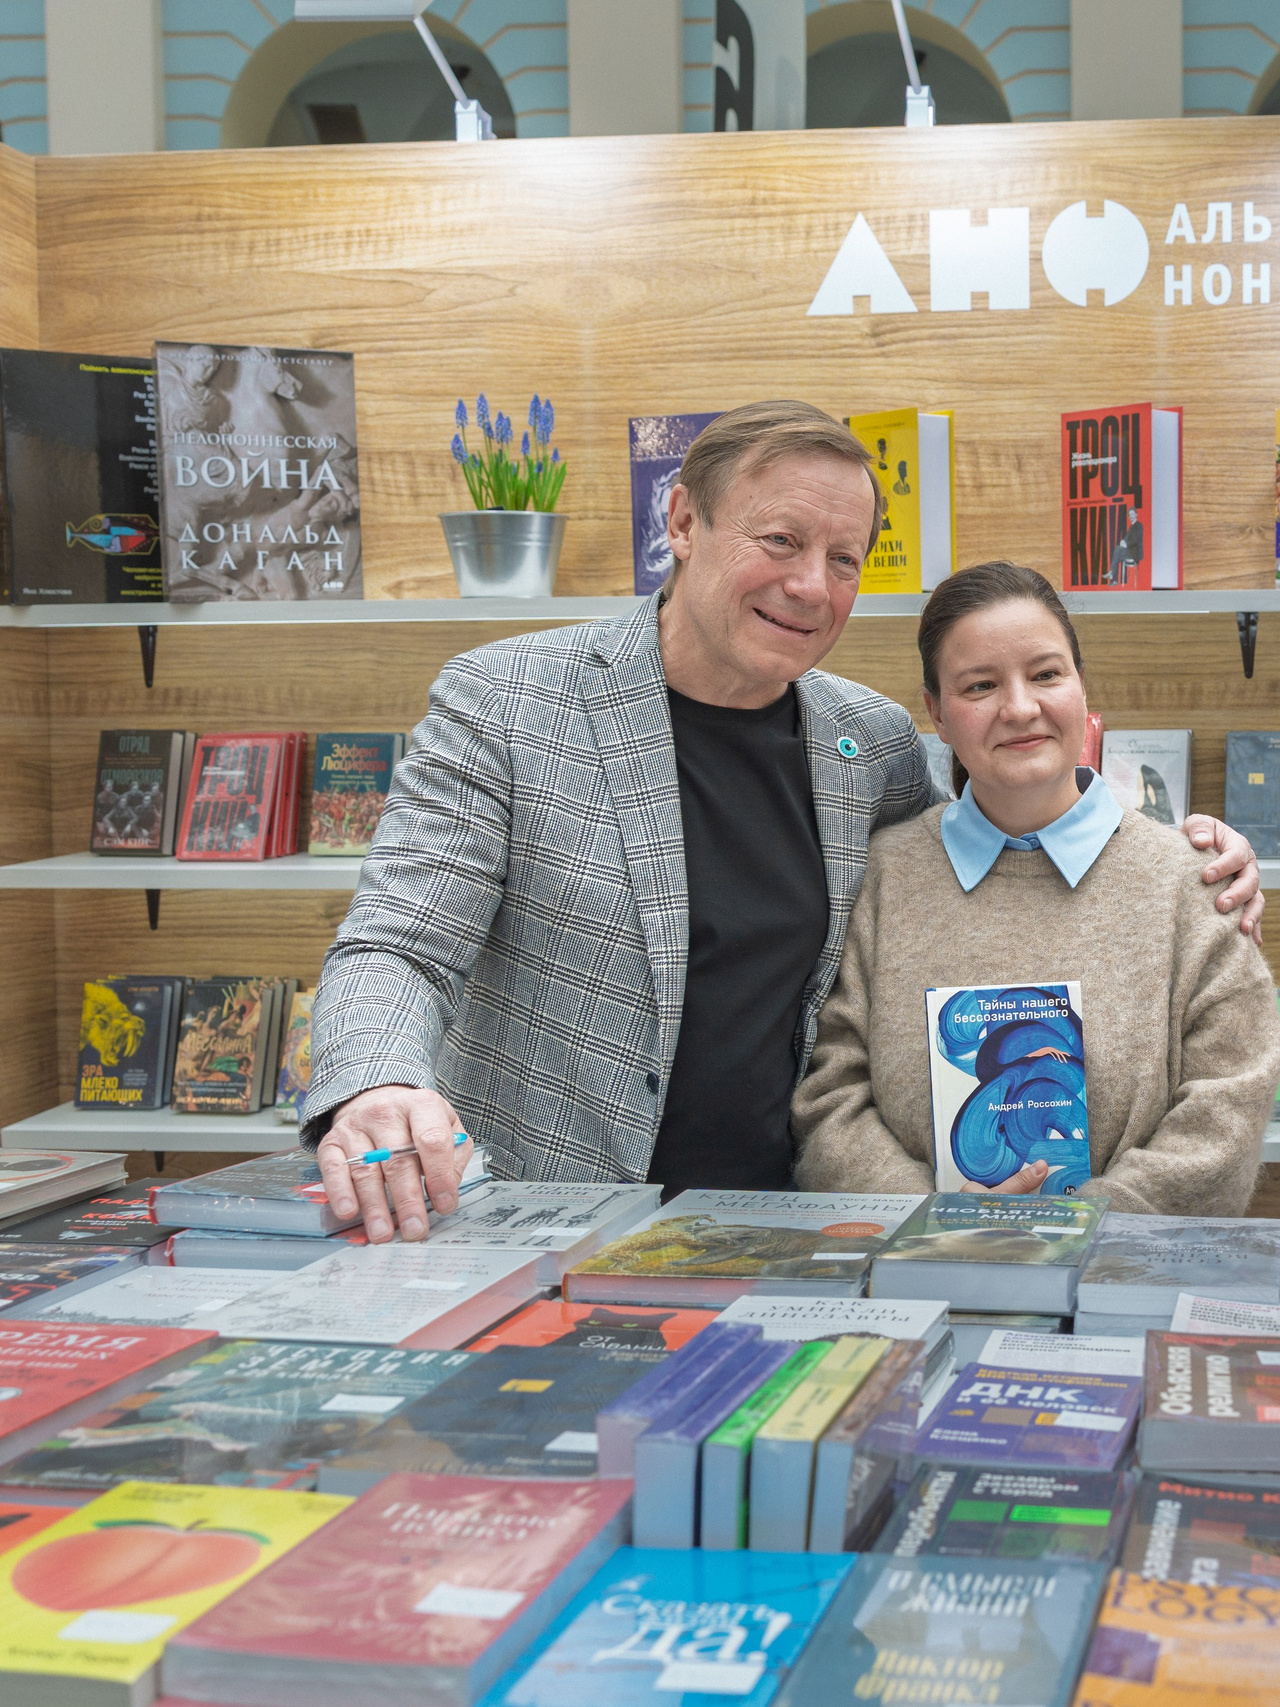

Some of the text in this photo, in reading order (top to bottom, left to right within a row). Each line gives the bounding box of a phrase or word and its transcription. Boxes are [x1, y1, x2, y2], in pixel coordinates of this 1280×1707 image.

[173, 431, 338, 450] ПЕЛОПОННЕССКАЯ
[1066, 412, 1143, 509] ТРОЦ
[174, 451, 344, 491] ВОЙНА
[177, 522, 345, 545] ДОНАЛЬД
[872, 539, 903, 554] ТИХИ
[180, 550, 345, 572] КАГАН
[873, 553, 907, 569] ВЕЩИ
[119, 735, 150, 754] ОТРЯД
[331, 743, 379, 761] Эффект
[321, 755, 387, 775] Люцифера
[197, 745, 270, 805] ТРОЦ
[977, 997, 1069, 1011] Тайны нашего
[954, 1008, 1069, 1024] бессознательного
[82, 1064, 103, 1077] ЭРА
[81, 1076, 119, 1089] МЛЕКО
[80, 1088, 144, 1102] ПИТАЮЩИХ
[988, 1099, 1073, 1112] Андрей Россохин
[523, 1184, 614, 1192] Первые
[698, 1193, 801, 1203] КОНЕЦ
[715, 1201, 907, 1212] МЕГАФАУНЫ
[930, 1206, 1089, 1218] НЕОБЪЯТНЫЙ
[979, 1213, 1032, 1221] МИР
[738, 1311, 910, 1322] ДИНОЗАВРЫ
[768, 1305, 897, 1314] УМИРАЛИ
[0, 1330, 147, 1351] РЕМЯ
[586, 1335, 616, 1343] ОТ
[0, 1346, 113, 1361] МЕННЫХ
[237, 1356, 401, 1376] ЗЕМЛИ
[960, 1381, 1084, 1404] ДНК
[1018, 1399, 1119, 1415] человек
[991, 1487, 1055, 1498] город
[1158, 1481, 1255, 1503] Митио
